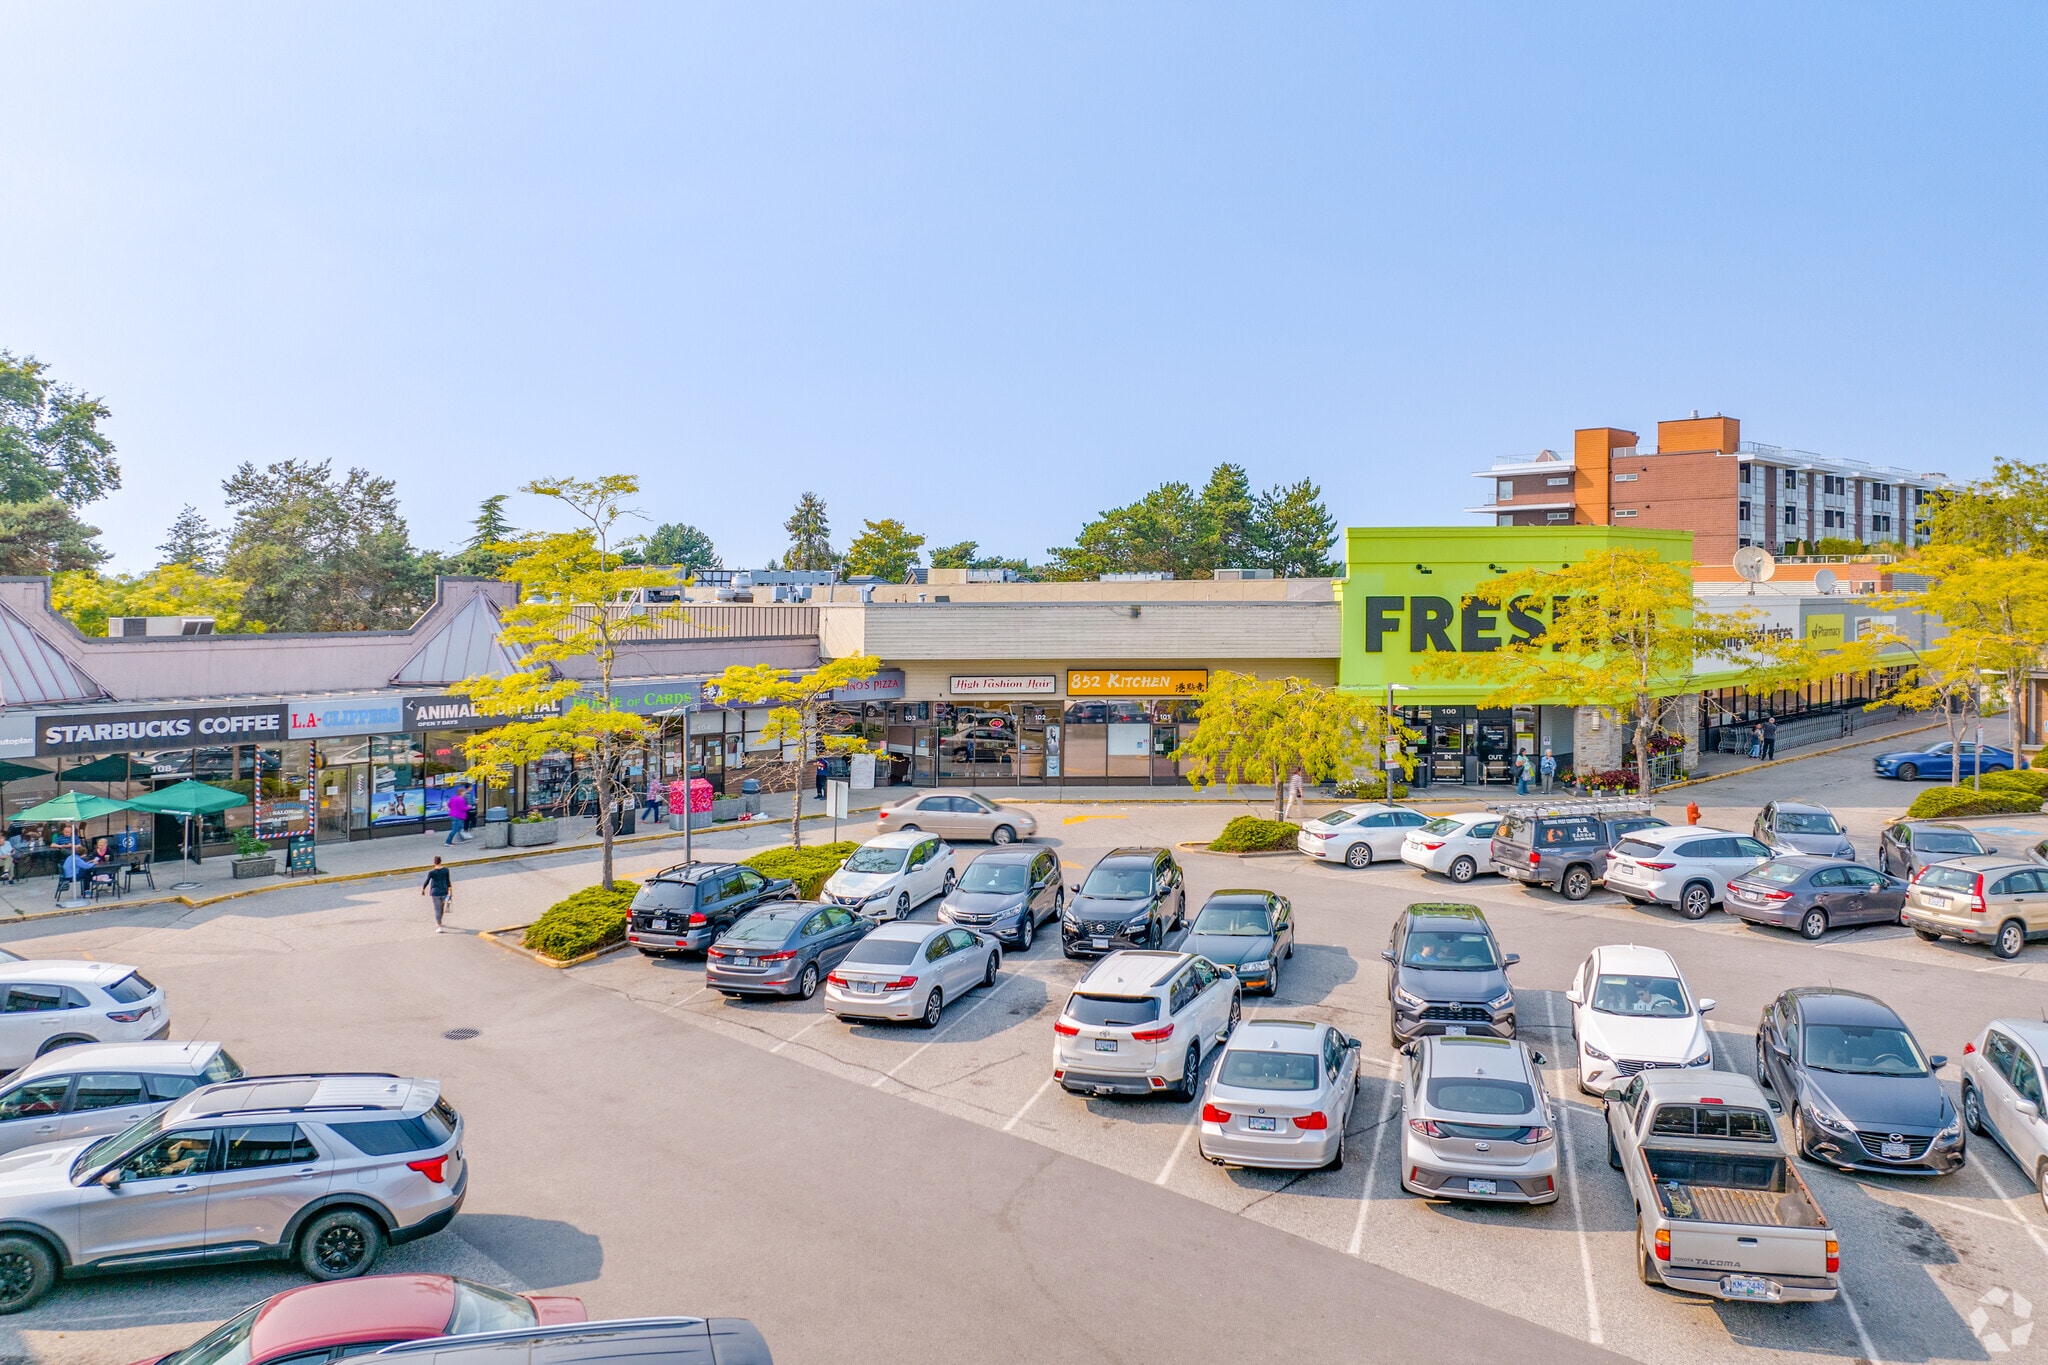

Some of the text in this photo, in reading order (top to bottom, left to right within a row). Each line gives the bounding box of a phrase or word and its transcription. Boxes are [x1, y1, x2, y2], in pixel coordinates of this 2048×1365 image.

[1818, 625, 1841, 638] Pharmacy
[842, 680, 899, 692] INO'S PIZZA
[954, 678, 1052, 690] High Fashion Hair
[1071, 673, 1171, 689] 852 KITCHEN
[644, 692, 691, 706] CARDS
[416, 703, 479, 720] ANIMAL
[45, 714, 280, 745] STARBUCKS COFFEE
[0, 737, 33, 746] utoplan
[150, 764, 173, 773] 108
[1695, 1258, 1741, 1267] TACOMA
